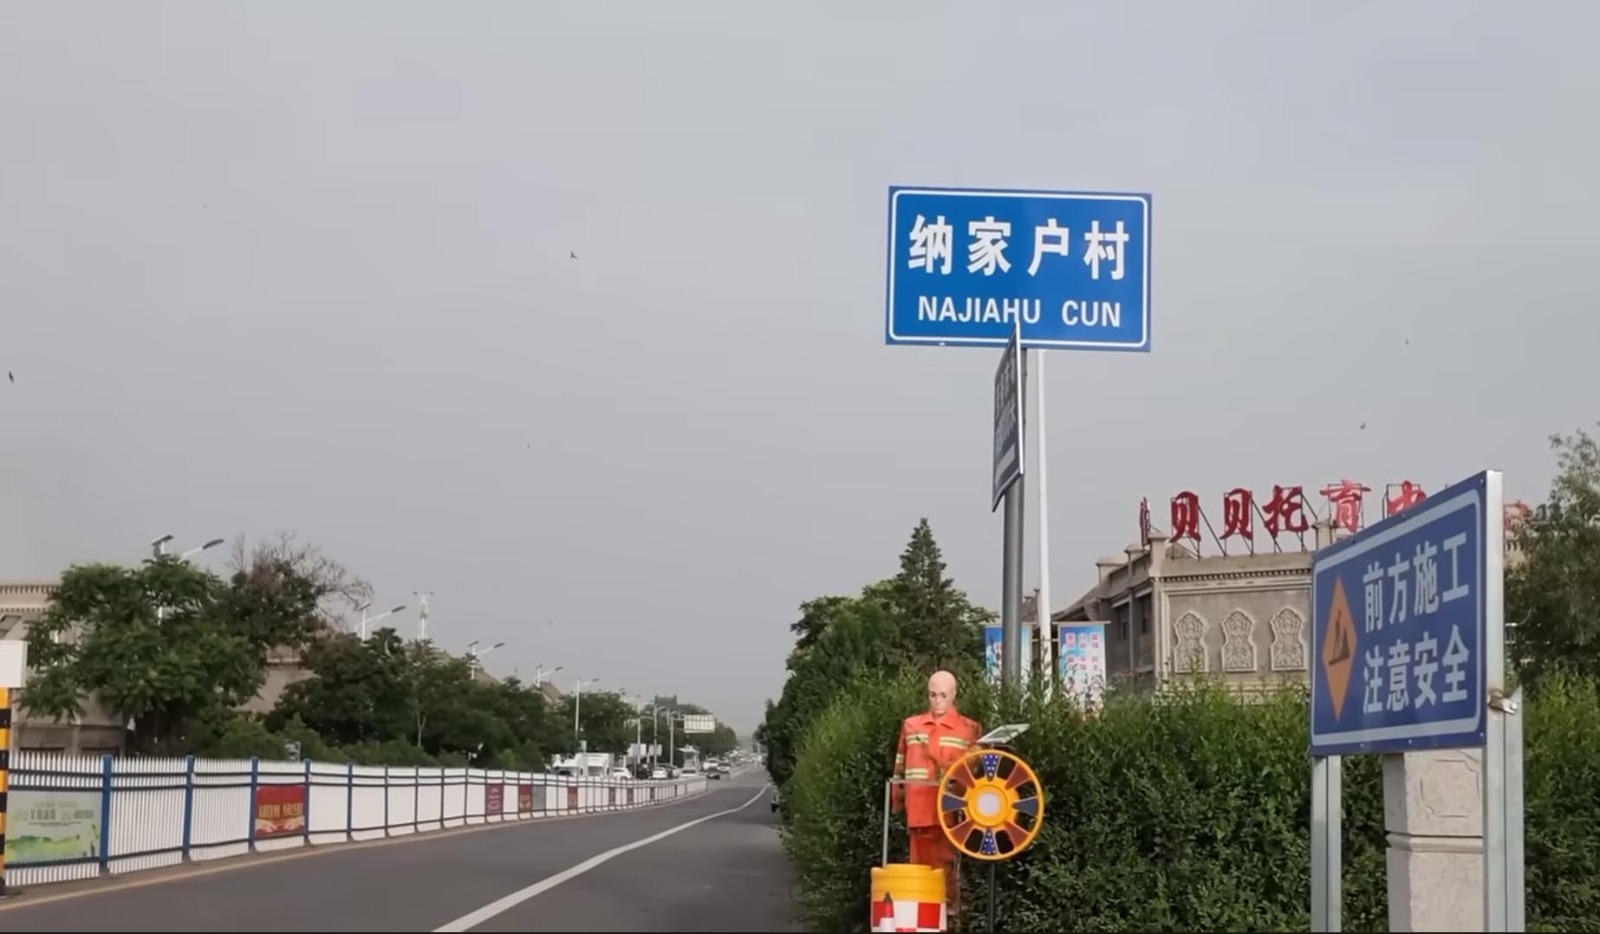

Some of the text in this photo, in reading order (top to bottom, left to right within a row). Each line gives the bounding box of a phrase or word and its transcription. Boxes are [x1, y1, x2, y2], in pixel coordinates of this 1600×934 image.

[908, 214, 1130, 280] 纳家户村
[917, 296, 1121, 327] NAJIAHU CUN
[1362, 532, 1469, 633] 前方施工
[1362, 624, 1470, 714] 注意安全
